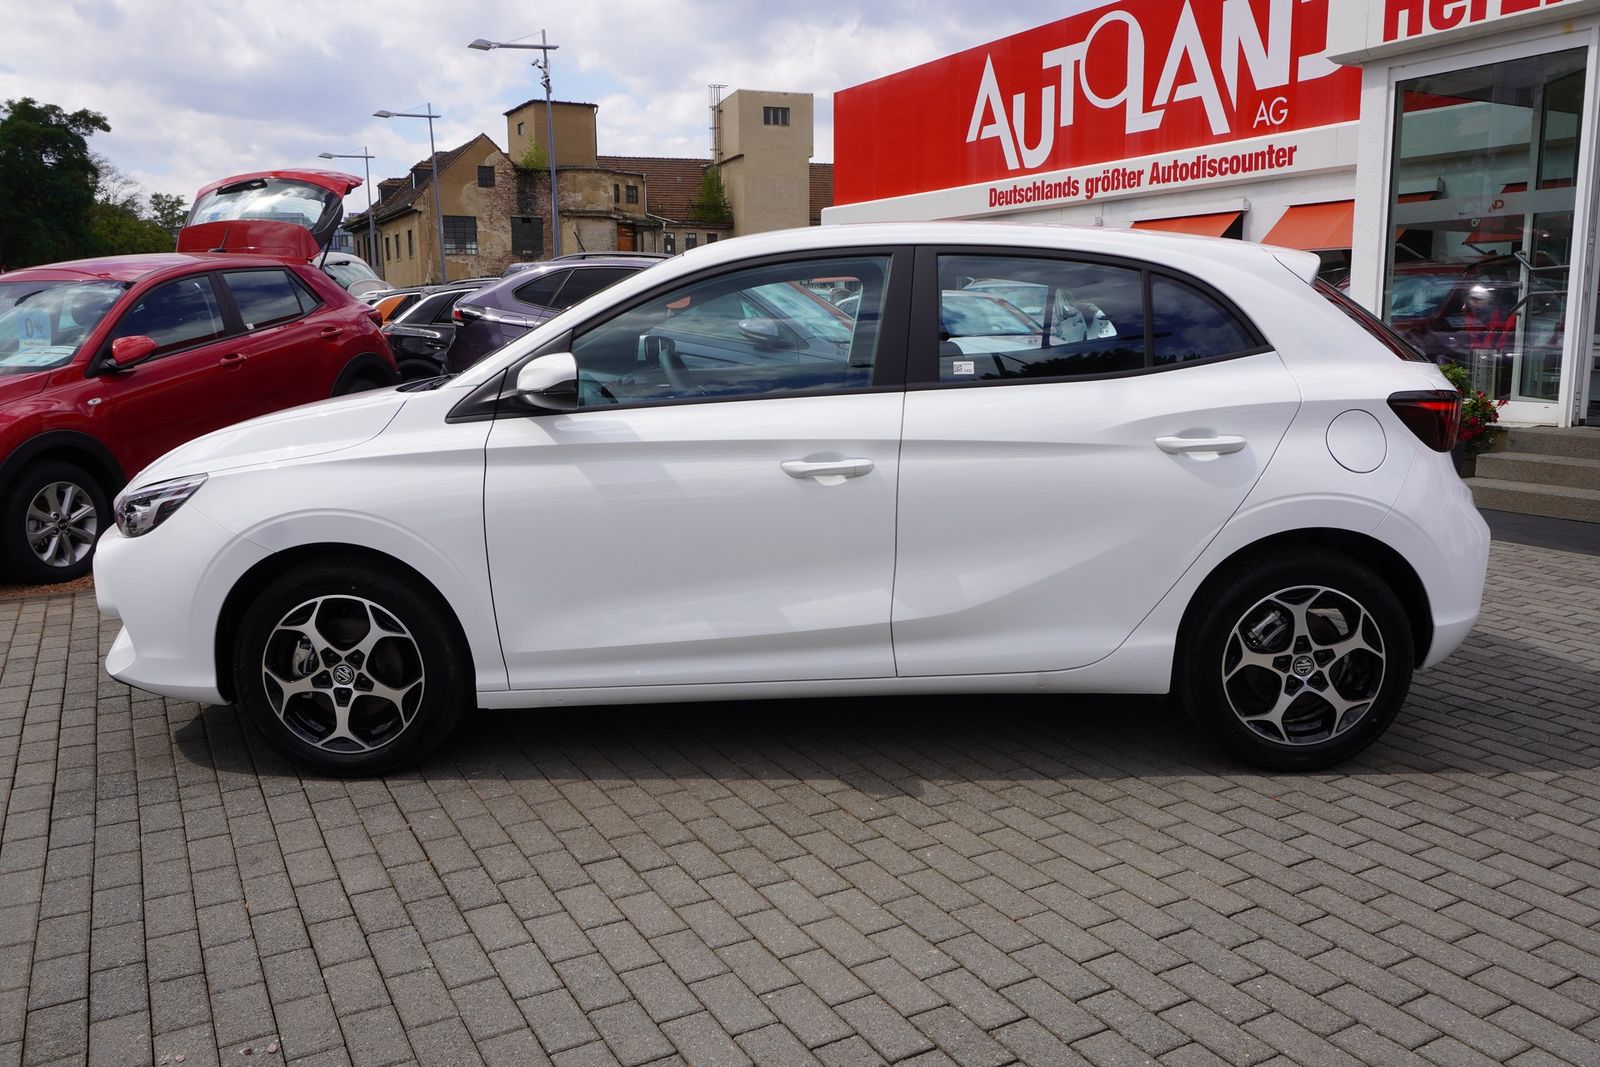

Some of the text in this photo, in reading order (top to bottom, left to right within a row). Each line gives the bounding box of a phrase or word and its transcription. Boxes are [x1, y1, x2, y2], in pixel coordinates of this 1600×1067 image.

[1253, 97, 1289, 128] AG
[989, 144, 1297, 207] Deutschlands größter Autodiscounter
